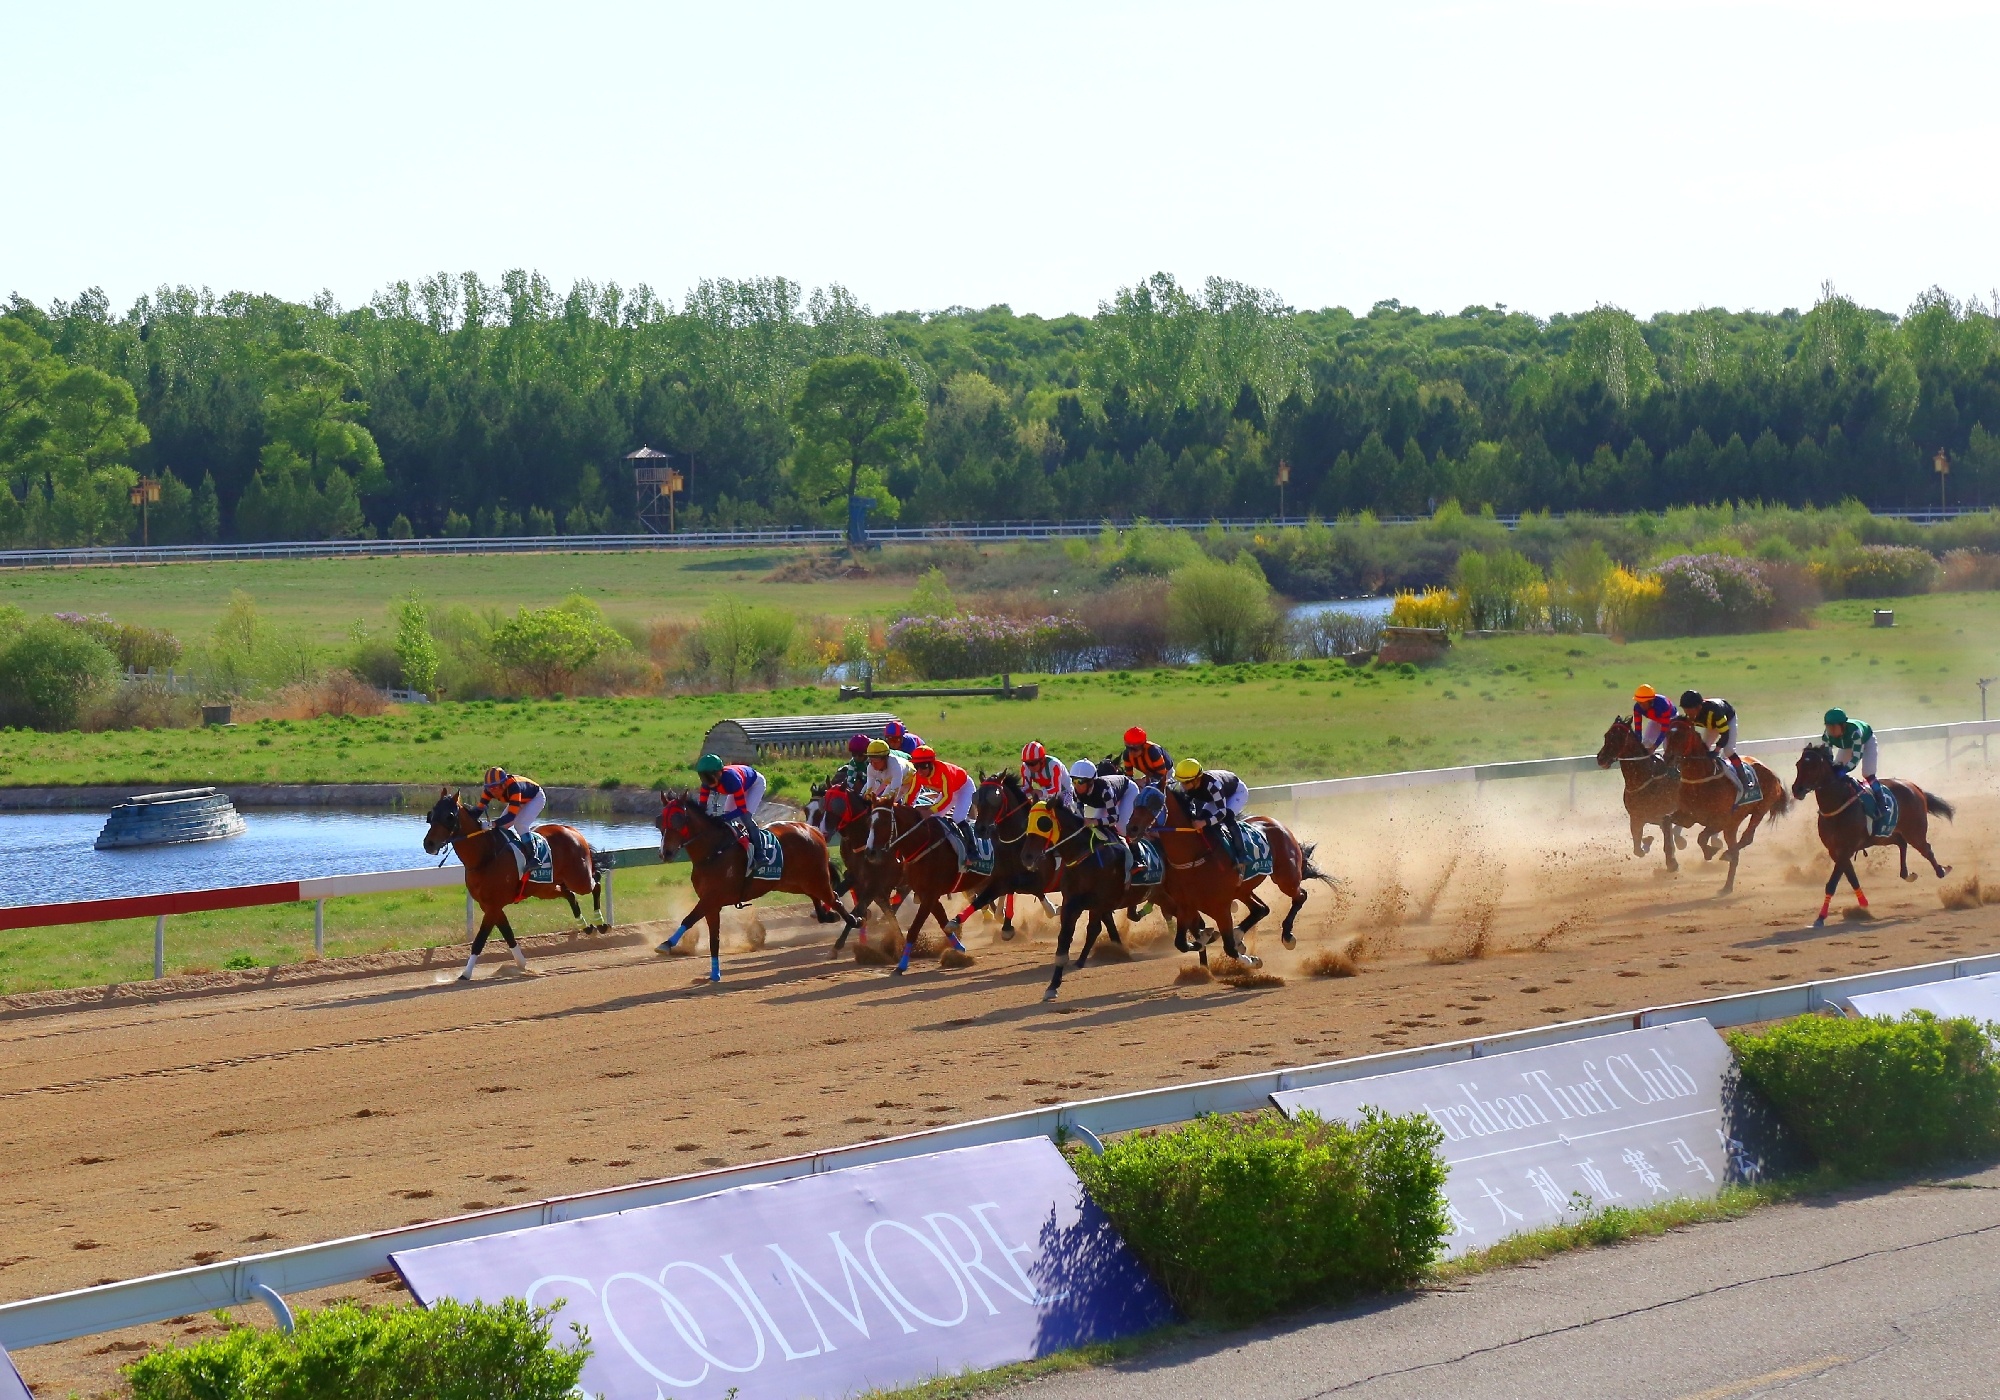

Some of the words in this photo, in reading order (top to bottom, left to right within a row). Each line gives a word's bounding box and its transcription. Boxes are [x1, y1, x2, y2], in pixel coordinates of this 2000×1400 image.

[1422, 1081, 1552, 1142] tralian
[1521, 1060, 1621, 1120] Turf
[1606, 1048, 1698, 1105] Club
[1442, 1129, 1760, 1237] 大利亚赛马会
